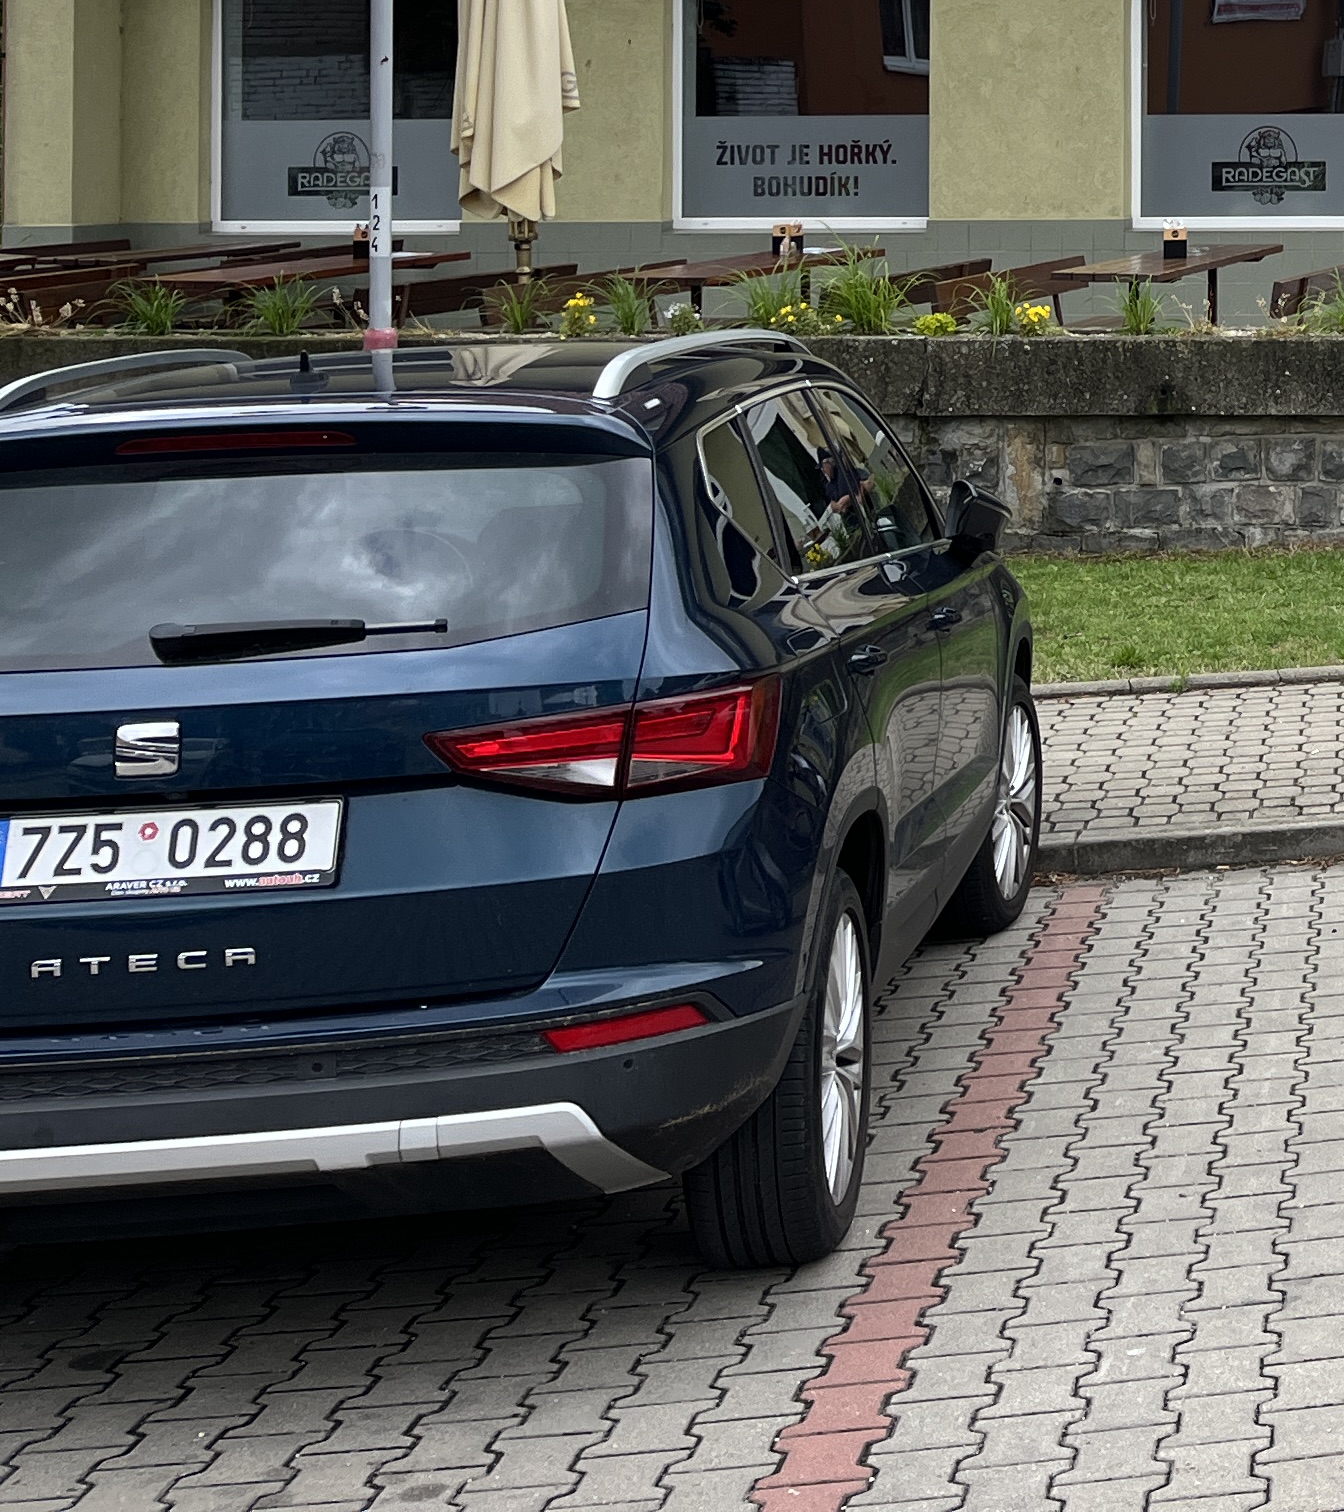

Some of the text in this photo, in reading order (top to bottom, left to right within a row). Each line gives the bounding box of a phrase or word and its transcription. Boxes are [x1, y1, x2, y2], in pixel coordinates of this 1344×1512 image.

[716, 139, 897, 165] ŽIVOT JE HOŘKÝ.
[298, 173, 371, 191] RADEGA
[753, 172, 859, 197] BOHUDÍK!
[1222, 167, 1319, 187] RADEGAST
[17, 813, 309, 879] 7Z5 0288
[105, 880, 147, 891] ARAVER
[149, 879, 164, 888] CZ
[31, 947, 256, 978] ATECA
